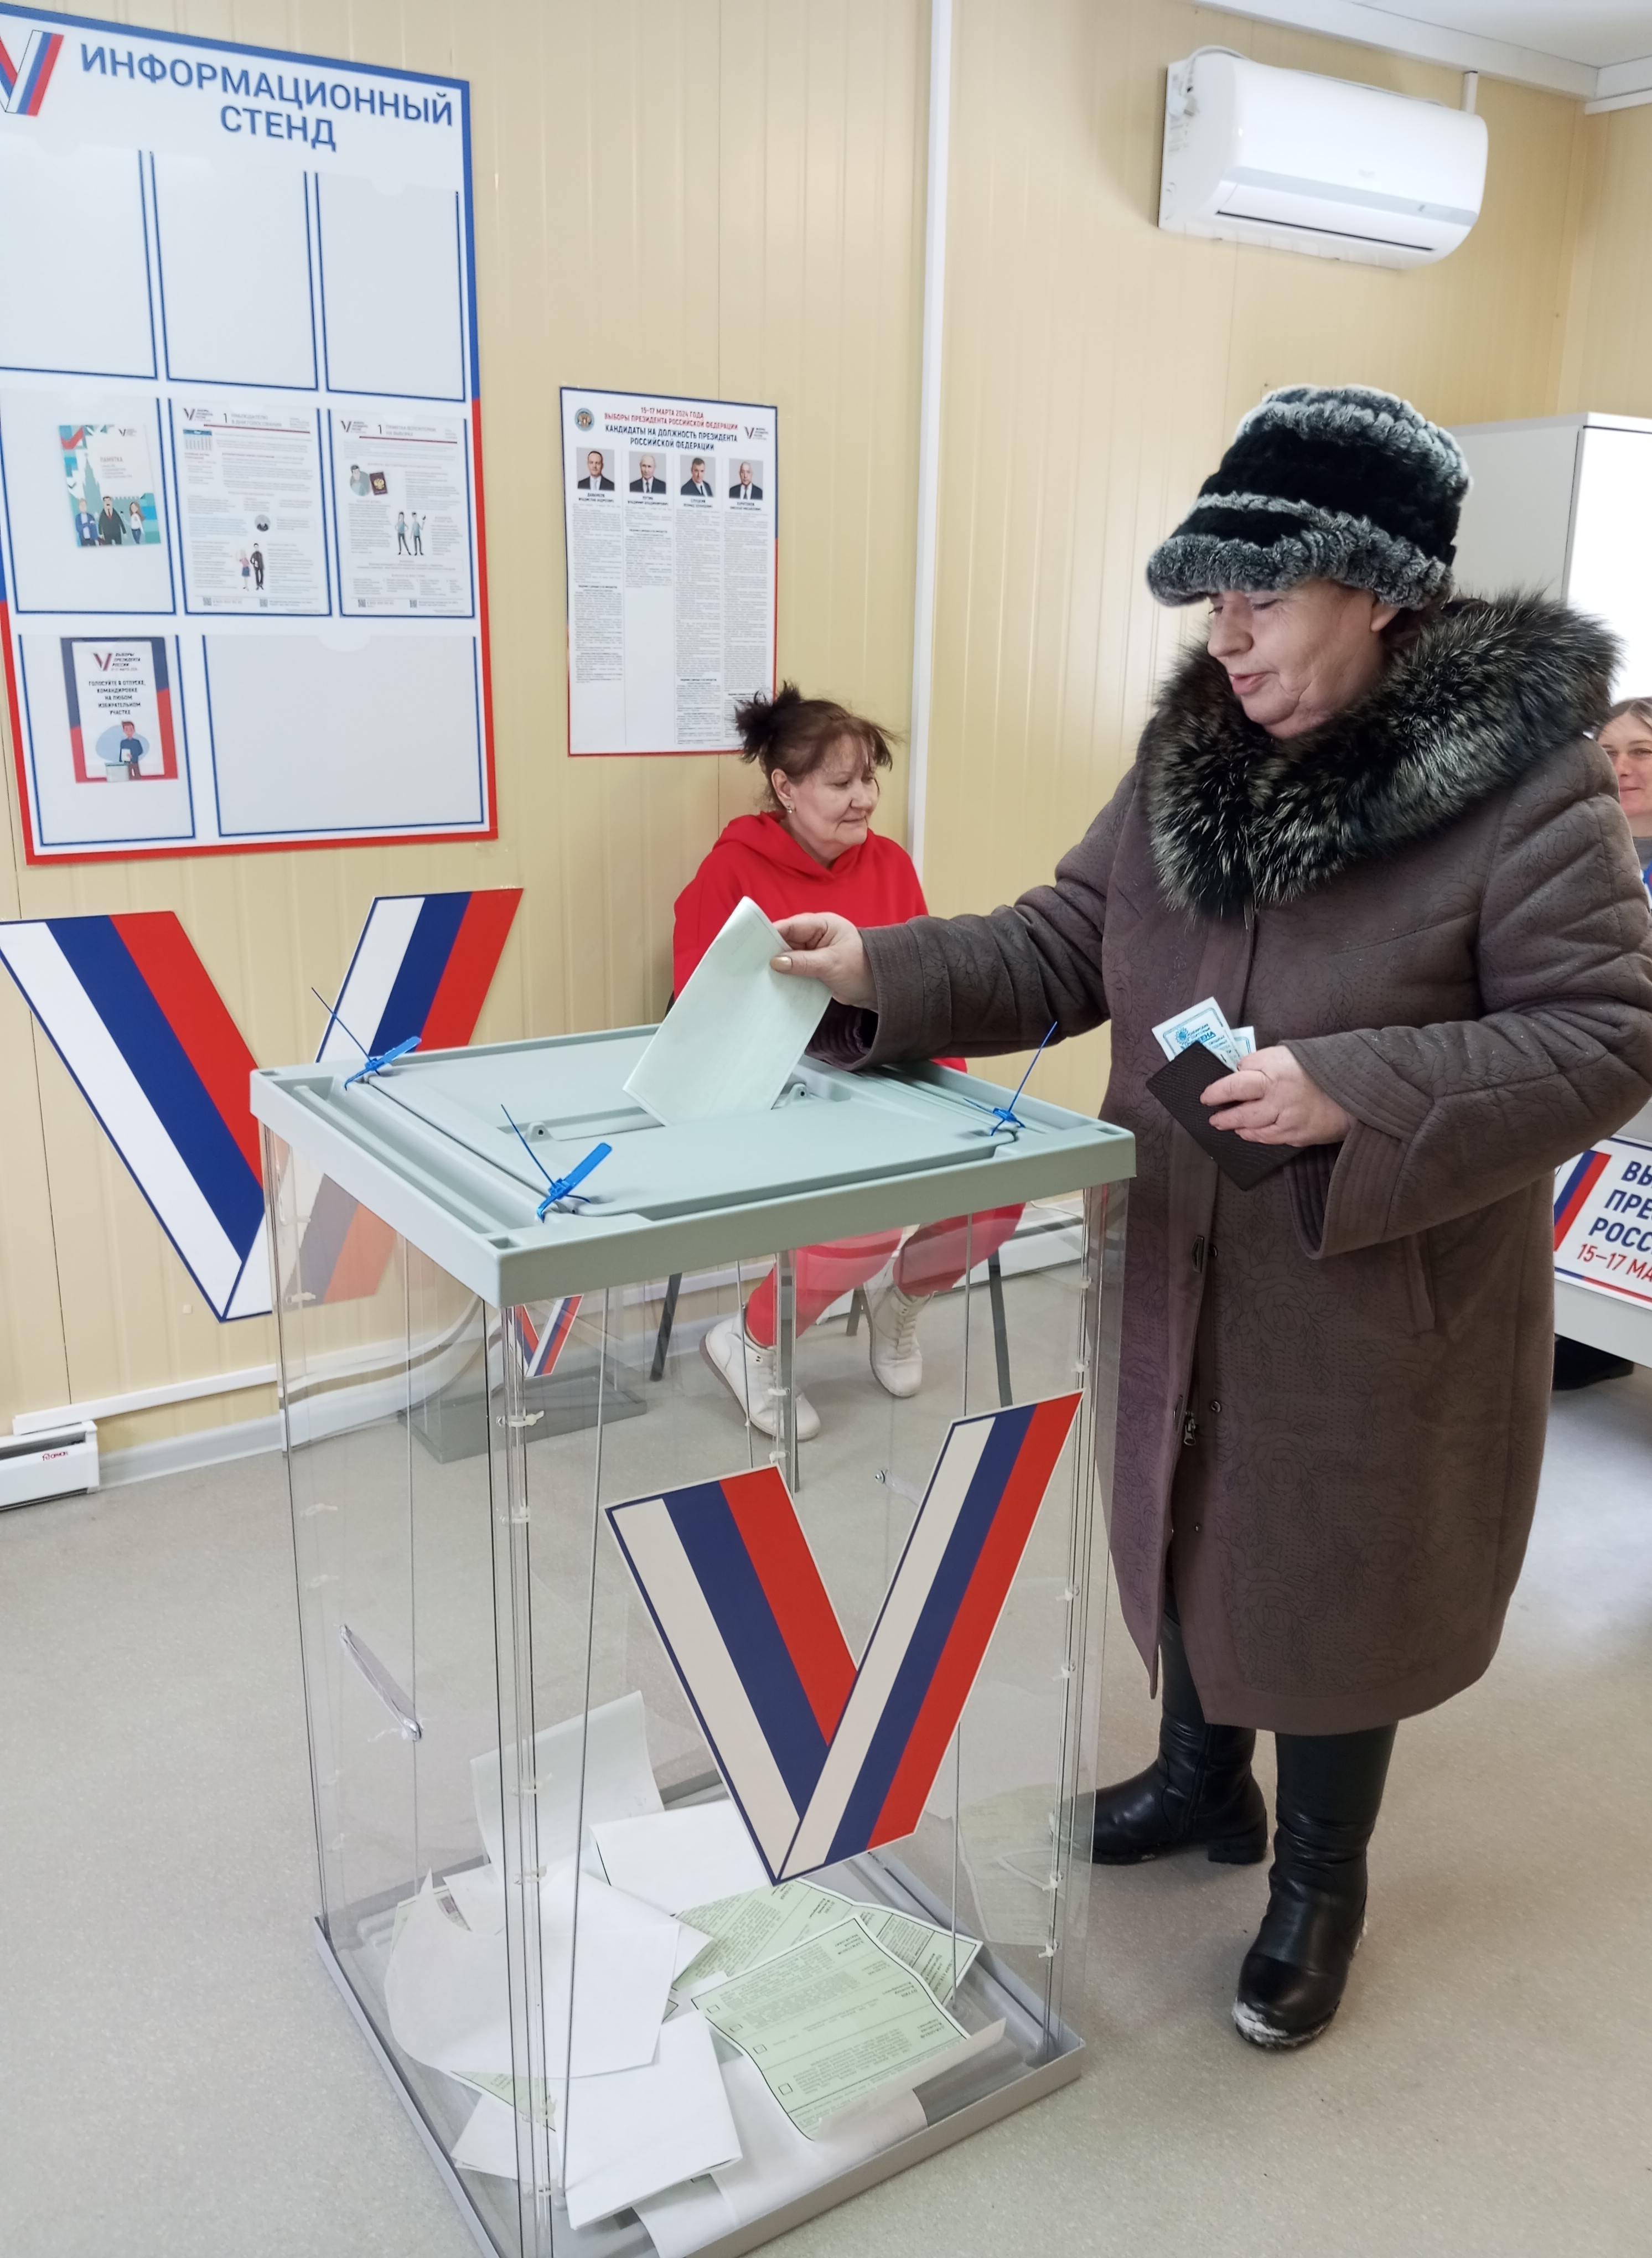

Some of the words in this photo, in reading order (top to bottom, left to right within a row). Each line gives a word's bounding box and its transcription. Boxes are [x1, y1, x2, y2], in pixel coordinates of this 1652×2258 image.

[80, 43, 453, 126] ИНФОРМАЦИОННЫЙ
[221, 105, 336, 152] СТЕНД
[605, 425, 645, 434] КАНДИДАТЫ
[657, 429, 697, 439] ДОЛЖНОСТЬ
[698, 432, 737, 442] ПРЕЗИДЕНТА
[631, 415, 667, 424] ПРЕЗИДЕНТА
[669, 418, 704, 427] РОССИЙСКОЙ
[706, 421, 738, 429] ФЕДЕРАЦИИ
[630, 437, 674, 447] РОССИЙСКОЙ
[676, 441, 714, 451] ФЕДЕРАЦИИ
[1604, 1189, 1652, 1220] ПРЕ
[1588, 1217, 1652, 1253] РОСС
